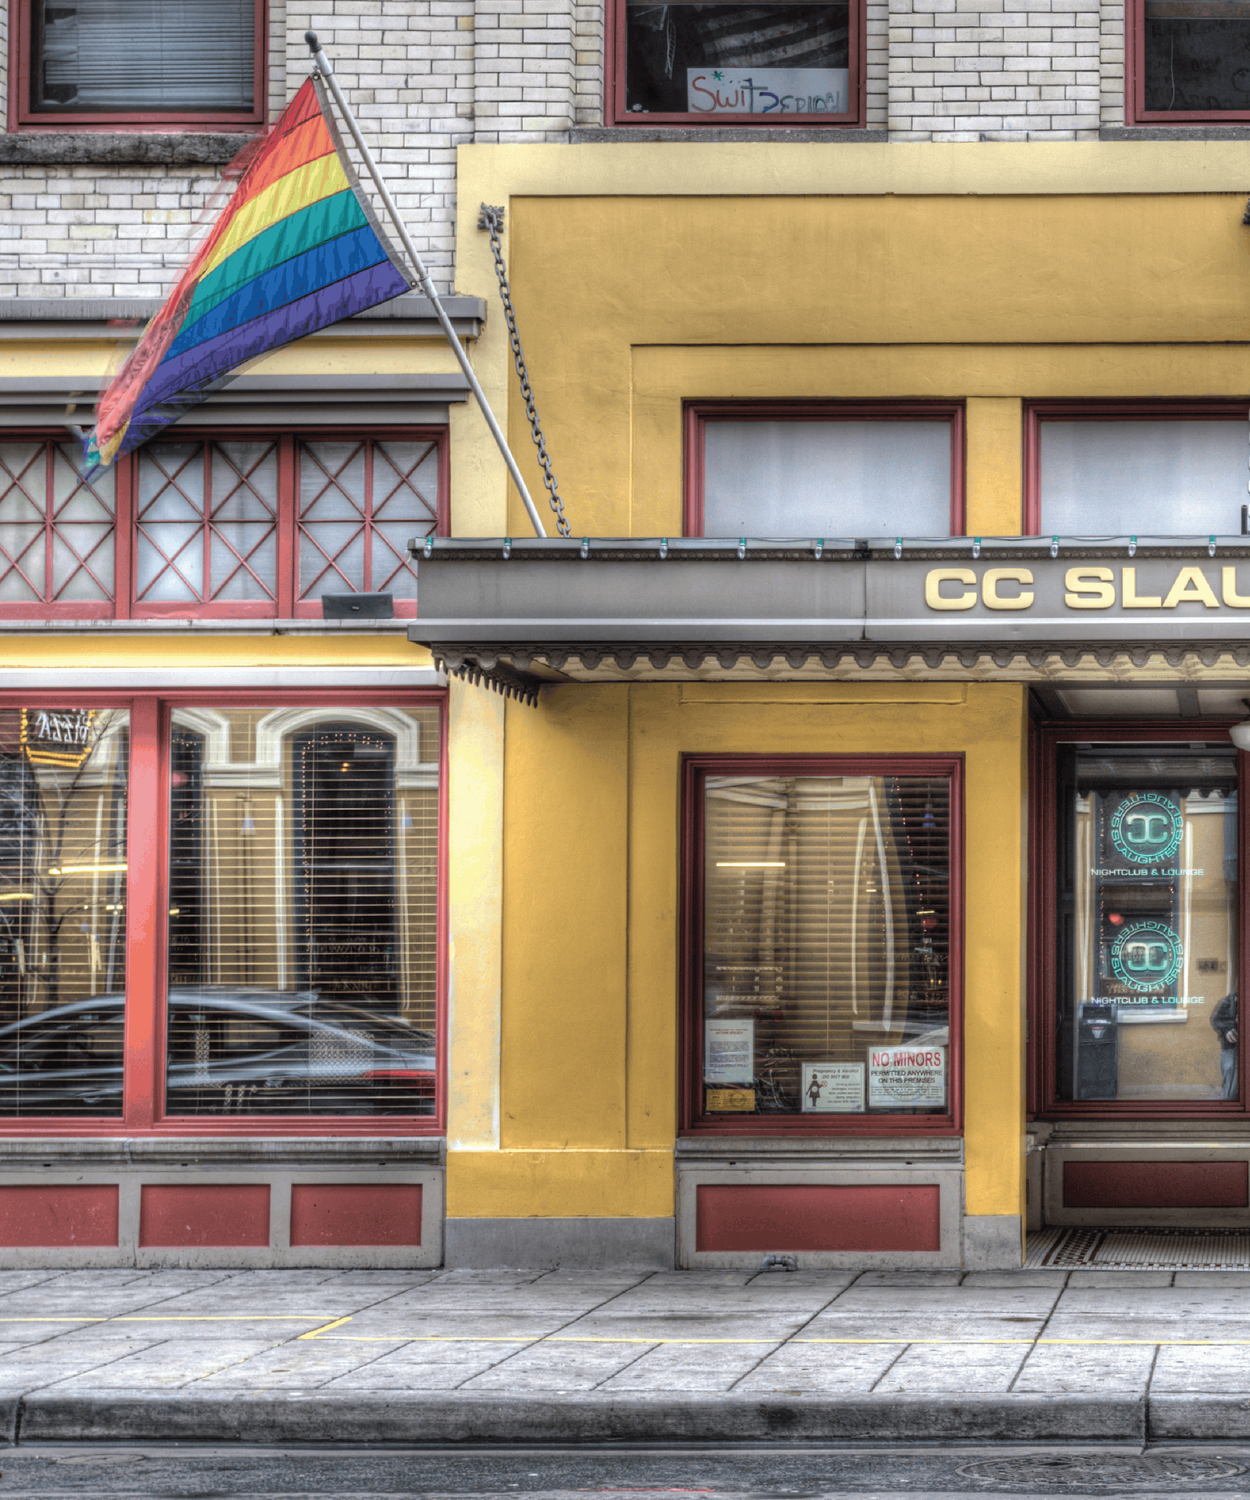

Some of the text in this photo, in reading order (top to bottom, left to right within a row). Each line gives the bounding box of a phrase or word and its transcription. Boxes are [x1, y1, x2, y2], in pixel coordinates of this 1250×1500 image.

[925, 567, 1034, 611] CC
[1090, 868, 1204, 876] NIGHTCLUB & LOUNGE
[1090, 996, 1205, 1004] NIGHTCLUB & LOUNGE
[872, 1052, 942, 1067] NO MINORS
